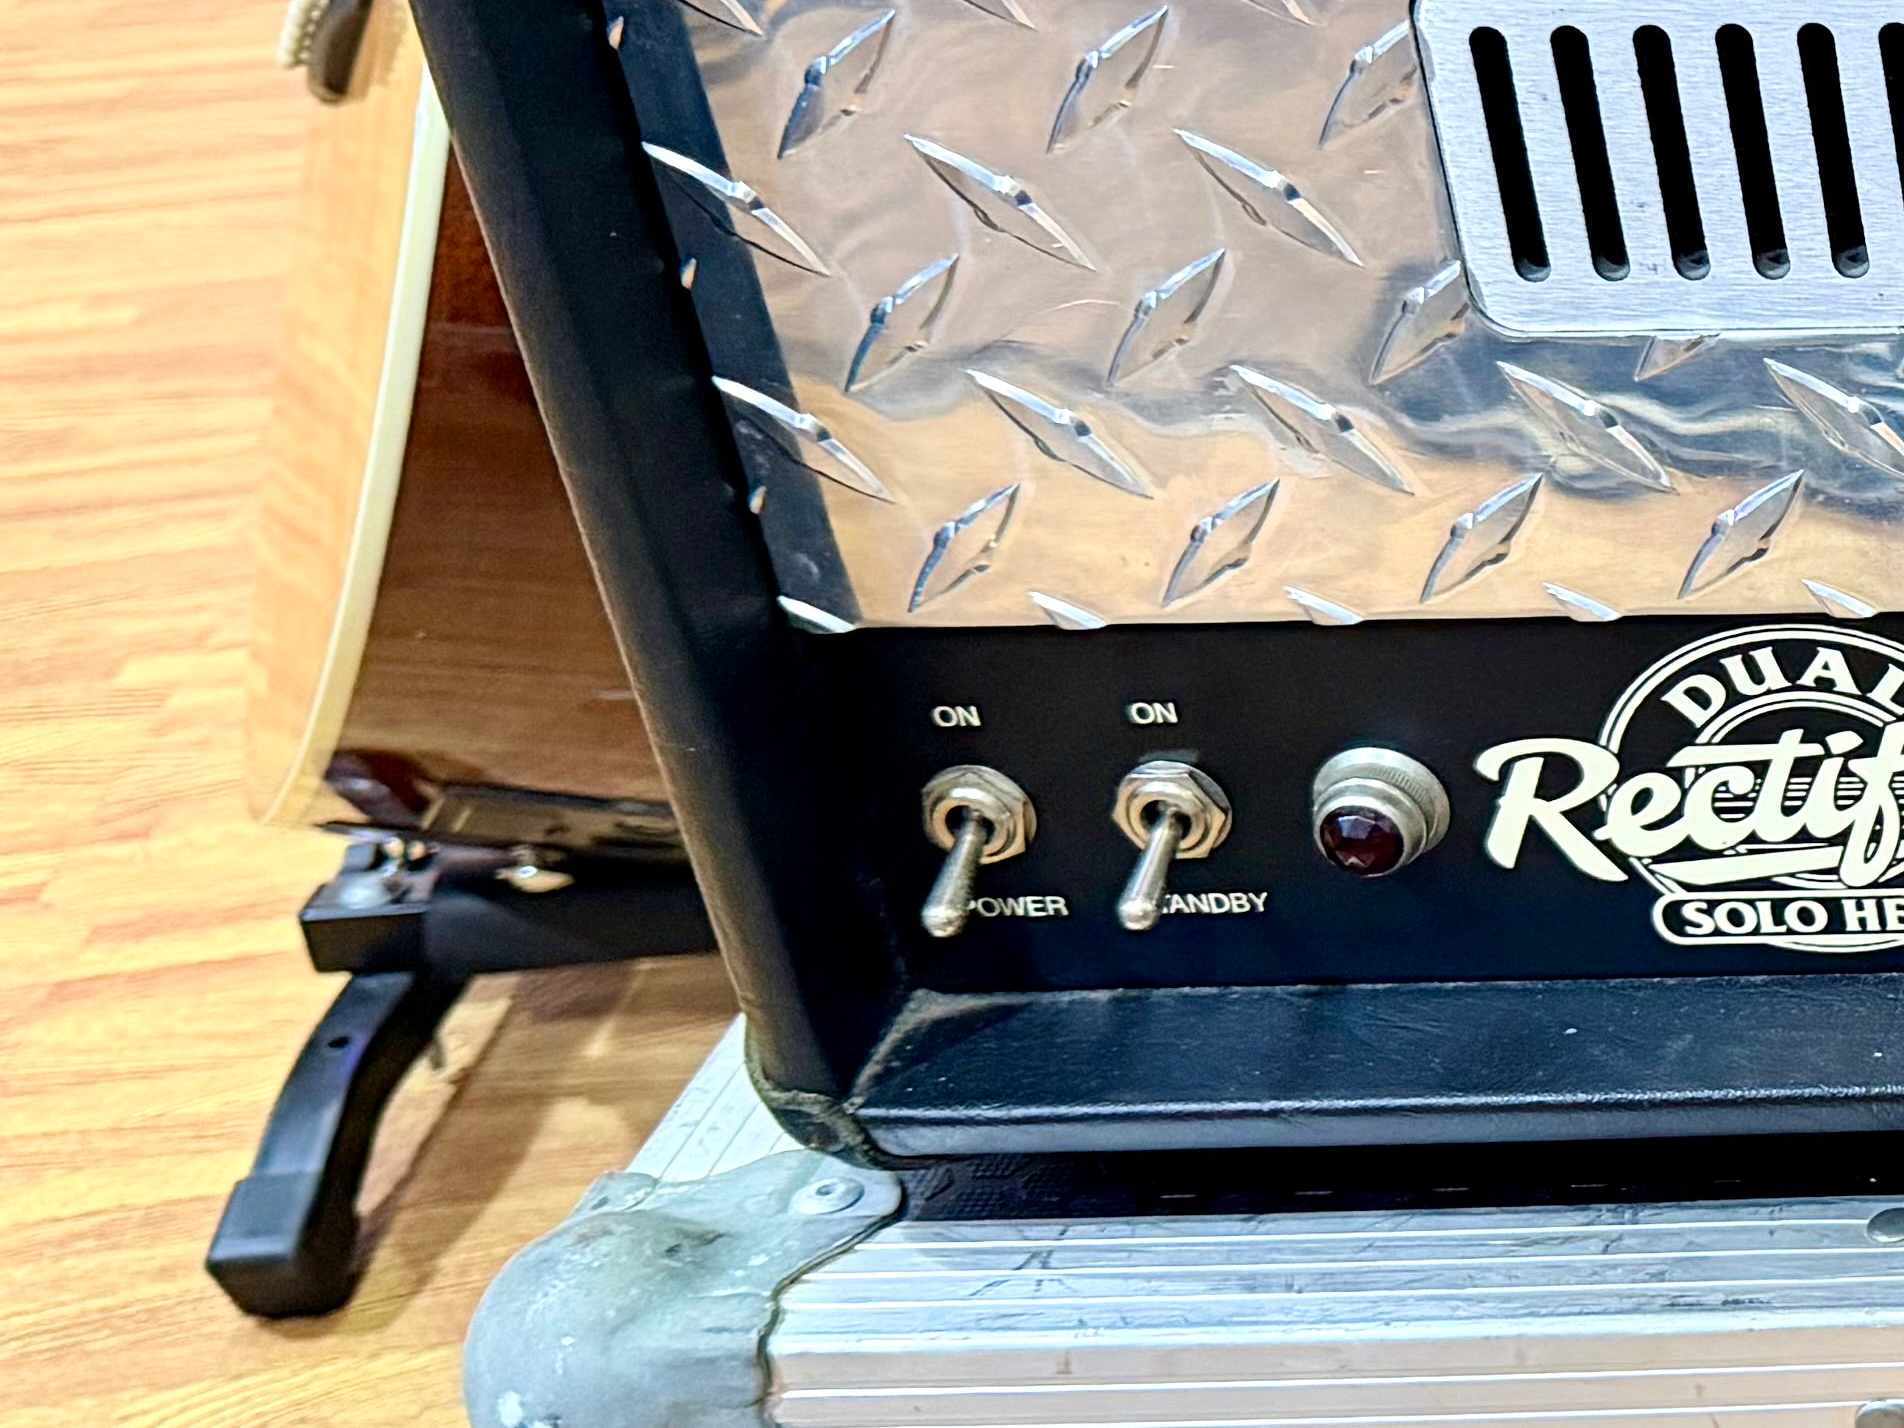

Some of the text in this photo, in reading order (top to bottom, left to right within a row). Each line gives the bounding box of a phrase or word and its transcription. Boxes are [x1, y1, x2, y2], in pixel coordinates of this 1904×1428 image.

[931, 704, 982, 728] ON
[1128, 701, 1179, 725] ON
[966, 895, 1070, 918] OWER
[1162, 891, 1269, 915] ANDBY
[1680, 900, 1829, 936] SOLO
